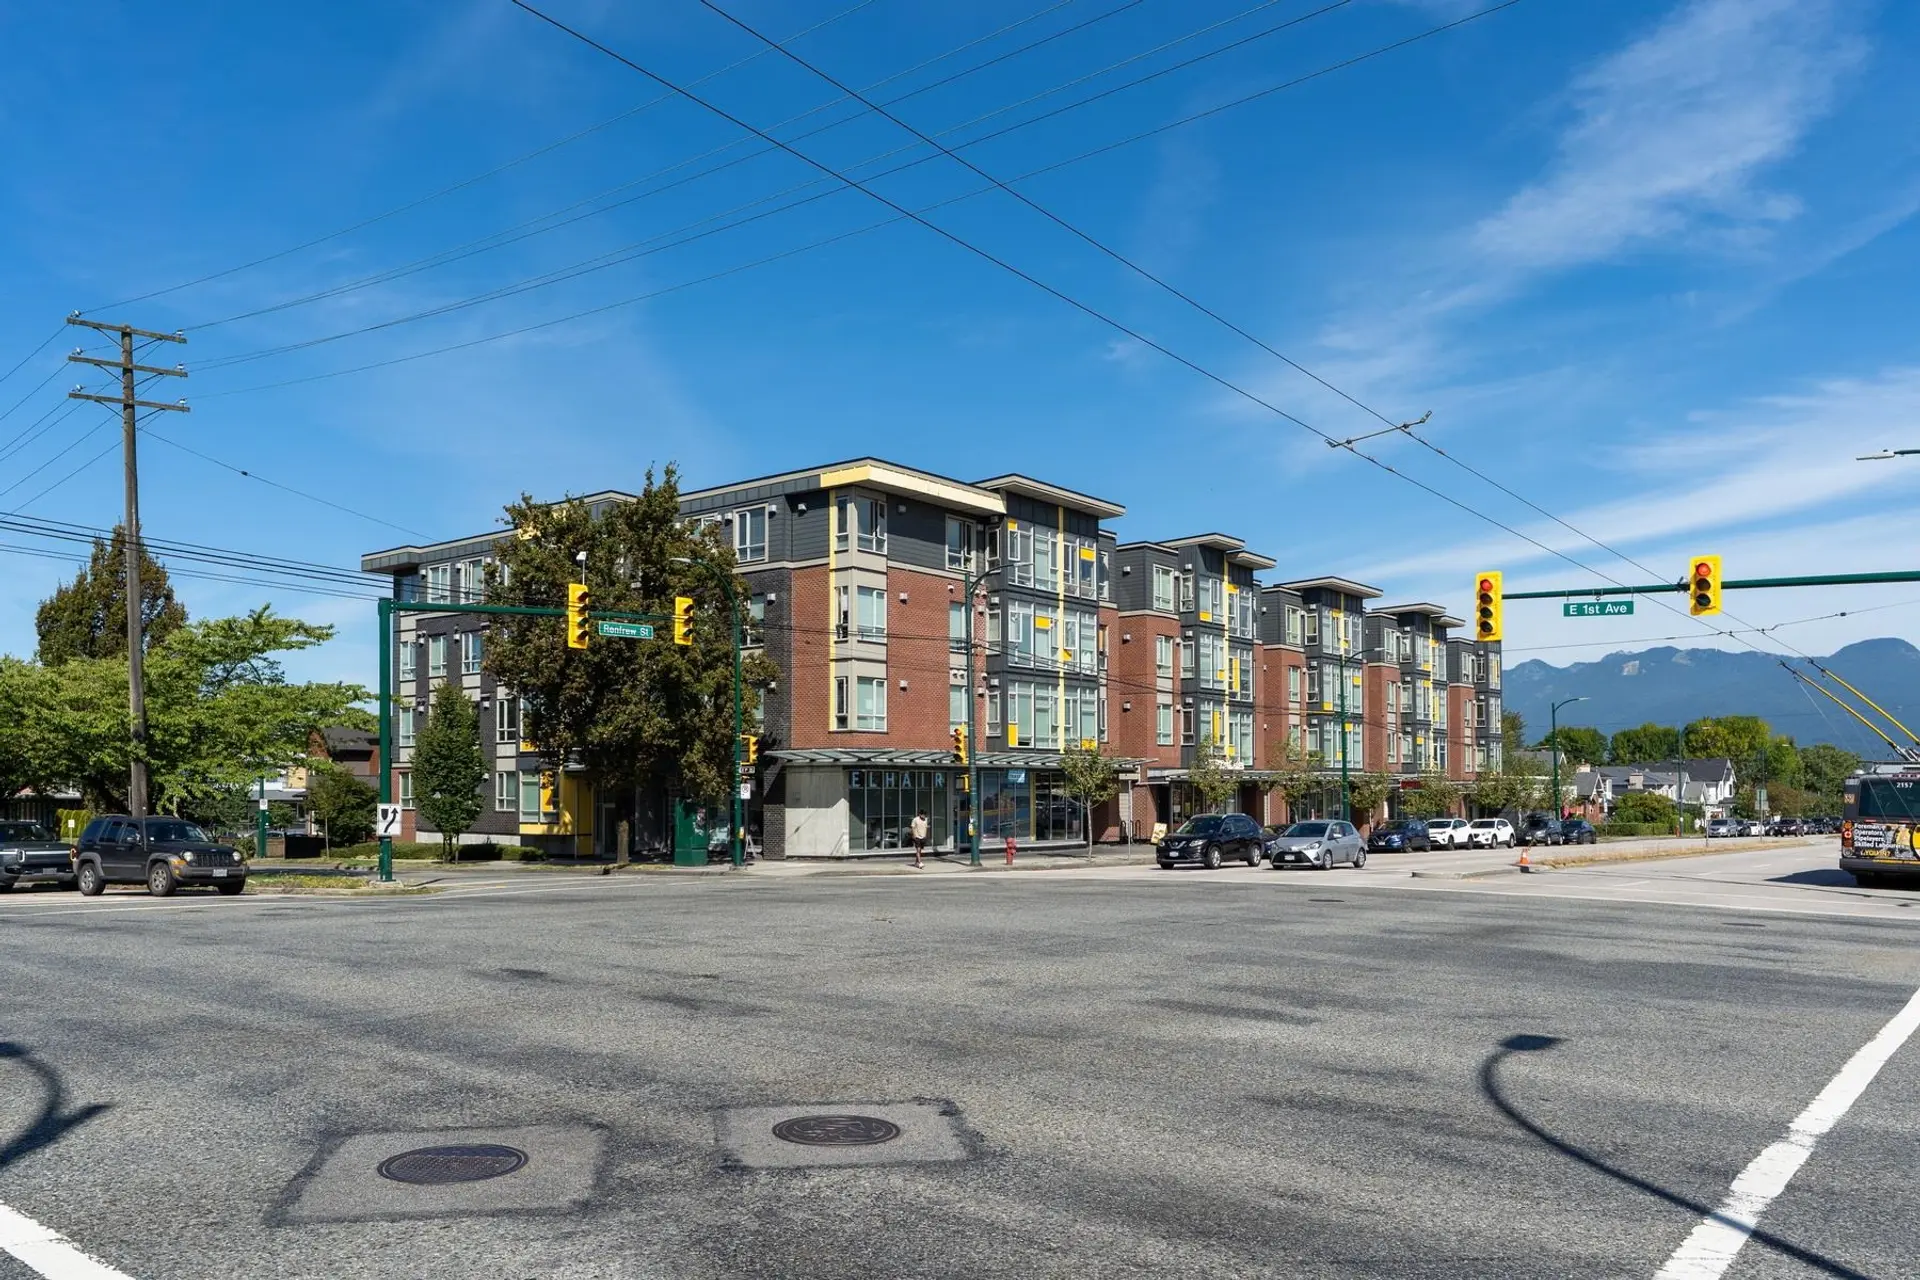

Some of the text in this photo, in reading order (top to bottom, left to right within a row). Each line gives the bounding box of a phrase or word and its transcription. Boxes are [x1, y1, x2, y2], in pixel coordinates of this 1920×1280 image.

[1570, 604, 1627, 614] E 1st Ave
[604, 624, 649, 636] Renfrew St
